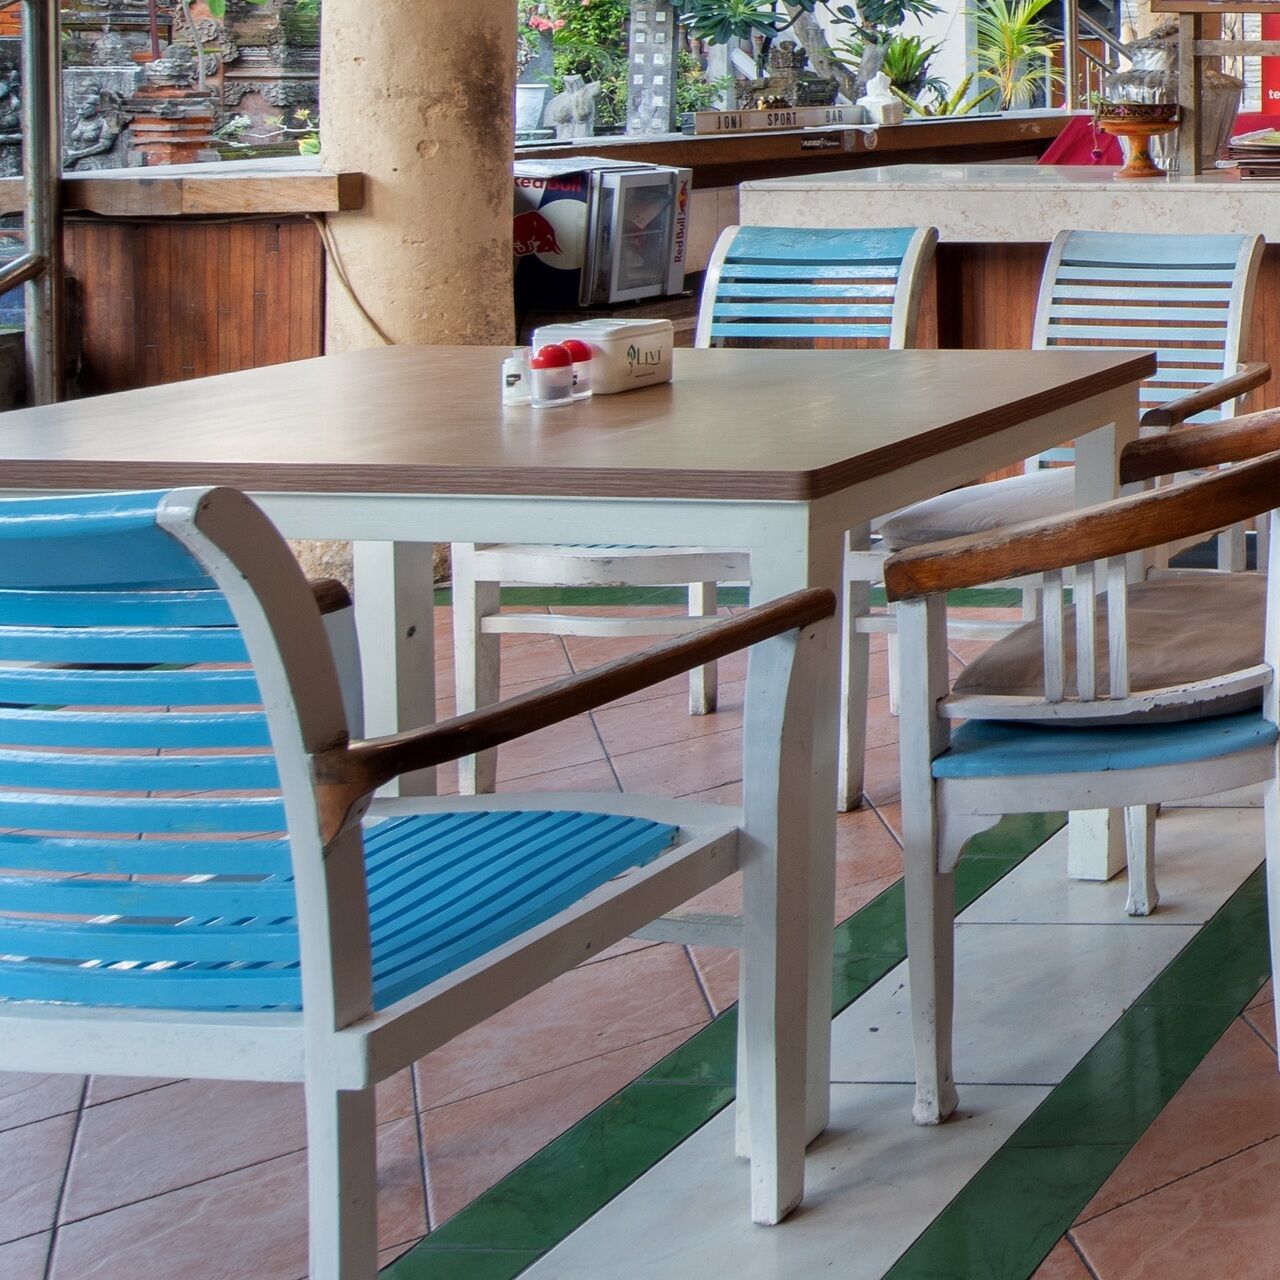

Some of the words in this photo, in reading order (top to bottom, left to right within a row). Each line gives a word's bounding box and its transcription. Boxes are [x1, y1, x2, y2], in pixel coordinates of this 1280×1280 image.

[716, 115, 743, 130] JONI
[767, 111, 797, 127] SPORT
[825, 109, 844, 123] BAR
[675, 217, 686, 239] Bull
[673, 239, 684, 263] Red
